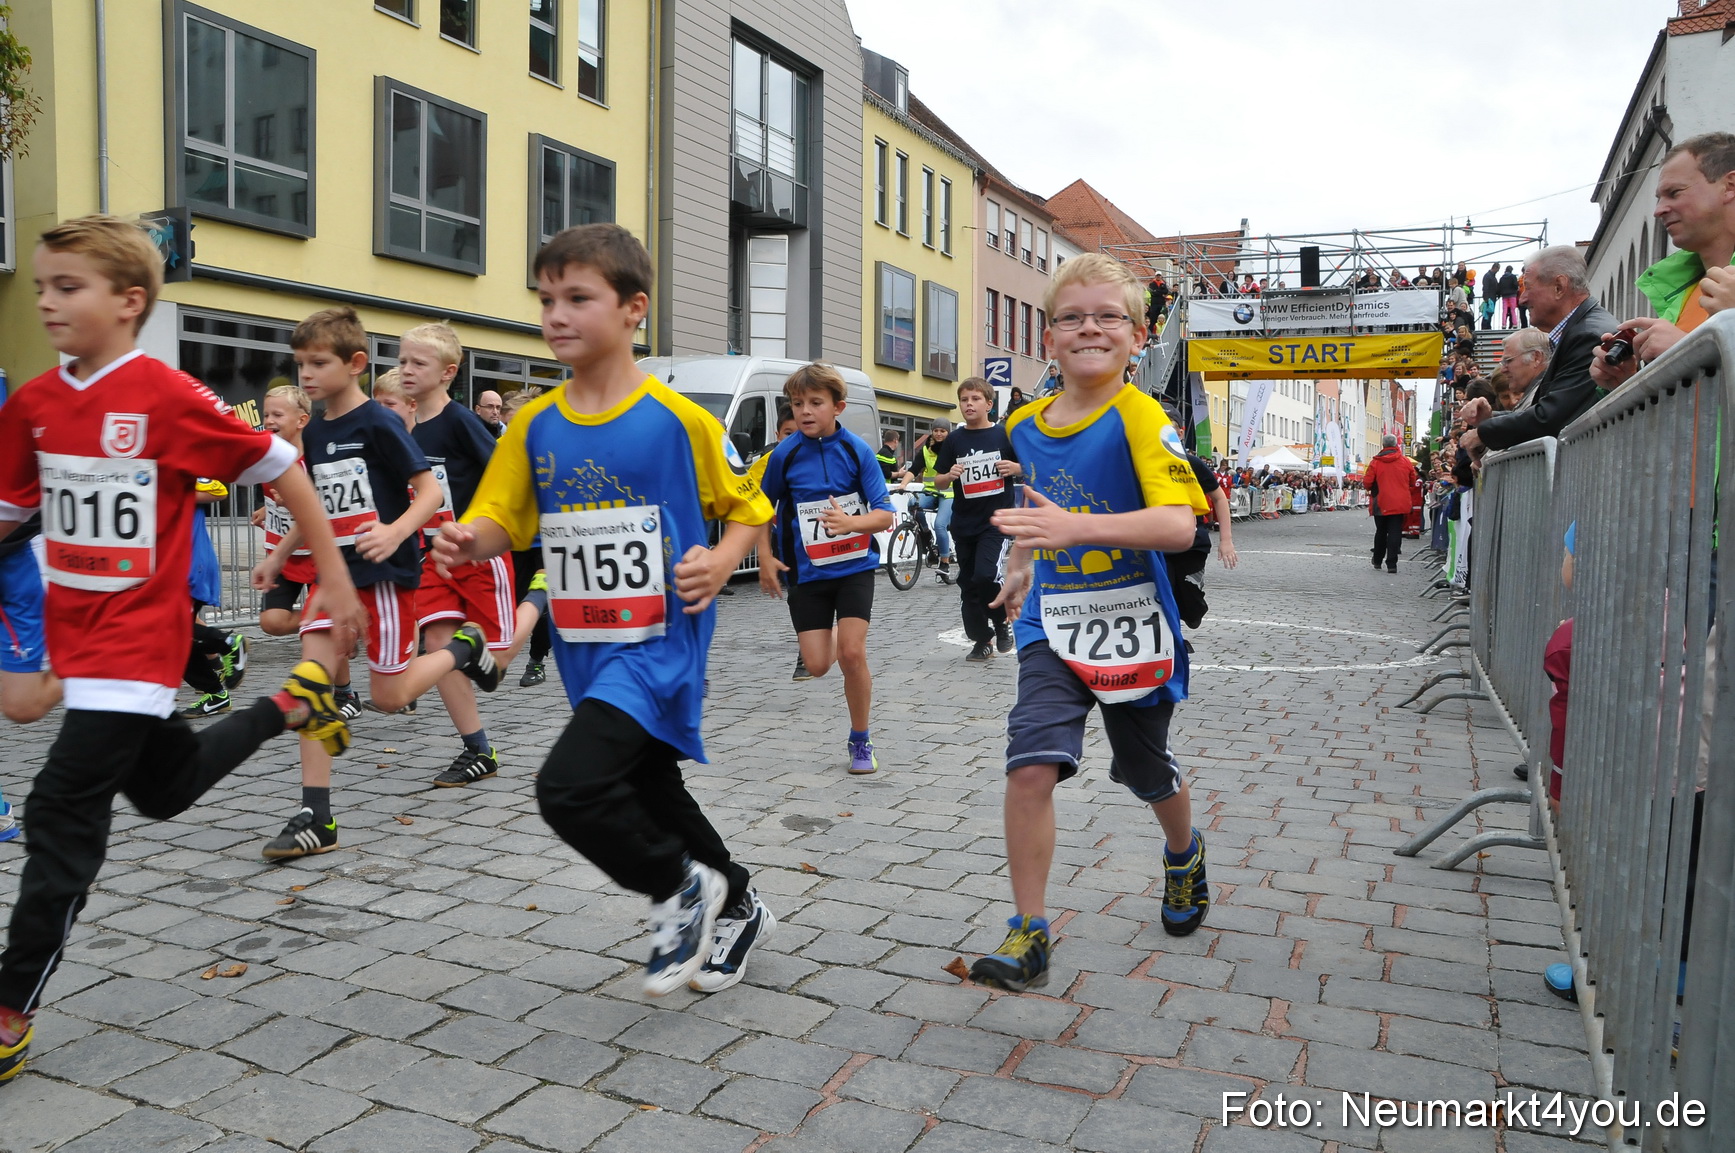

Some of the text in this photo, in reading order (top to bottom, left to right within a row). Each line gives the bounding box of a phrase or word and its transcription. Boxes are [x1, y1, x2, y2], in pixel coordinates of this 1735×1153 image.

[1260, 304, 1288, 314] BMW
[1290, 301, 1390, 314] EfficientDynamics
[1290, 311, 1328, 320] Verbrauch.
[1329, 310, 1348, 319] Mehr
[1268, 343, 1356, 364] START
[1244, 427, 1253, 447] Audi
[964, 463, 999, 482] 7544
[316, 480, 366, 514] 524
[43, 487, 139, 540] 7016
[799, 507, 821, 516] PARTL
[572, 521, 636, 537] Neumarkt
[831, 543, 852, 553] Finn
[550, 540, 650, 591] 7153
[583, 605, 617, 624] Elias
[1044, 596, 1152, 618] PARTL Neumarkt
[1057, 611, 1161, 660] 7231
[1090, 671, 1138, 687] Jonas
